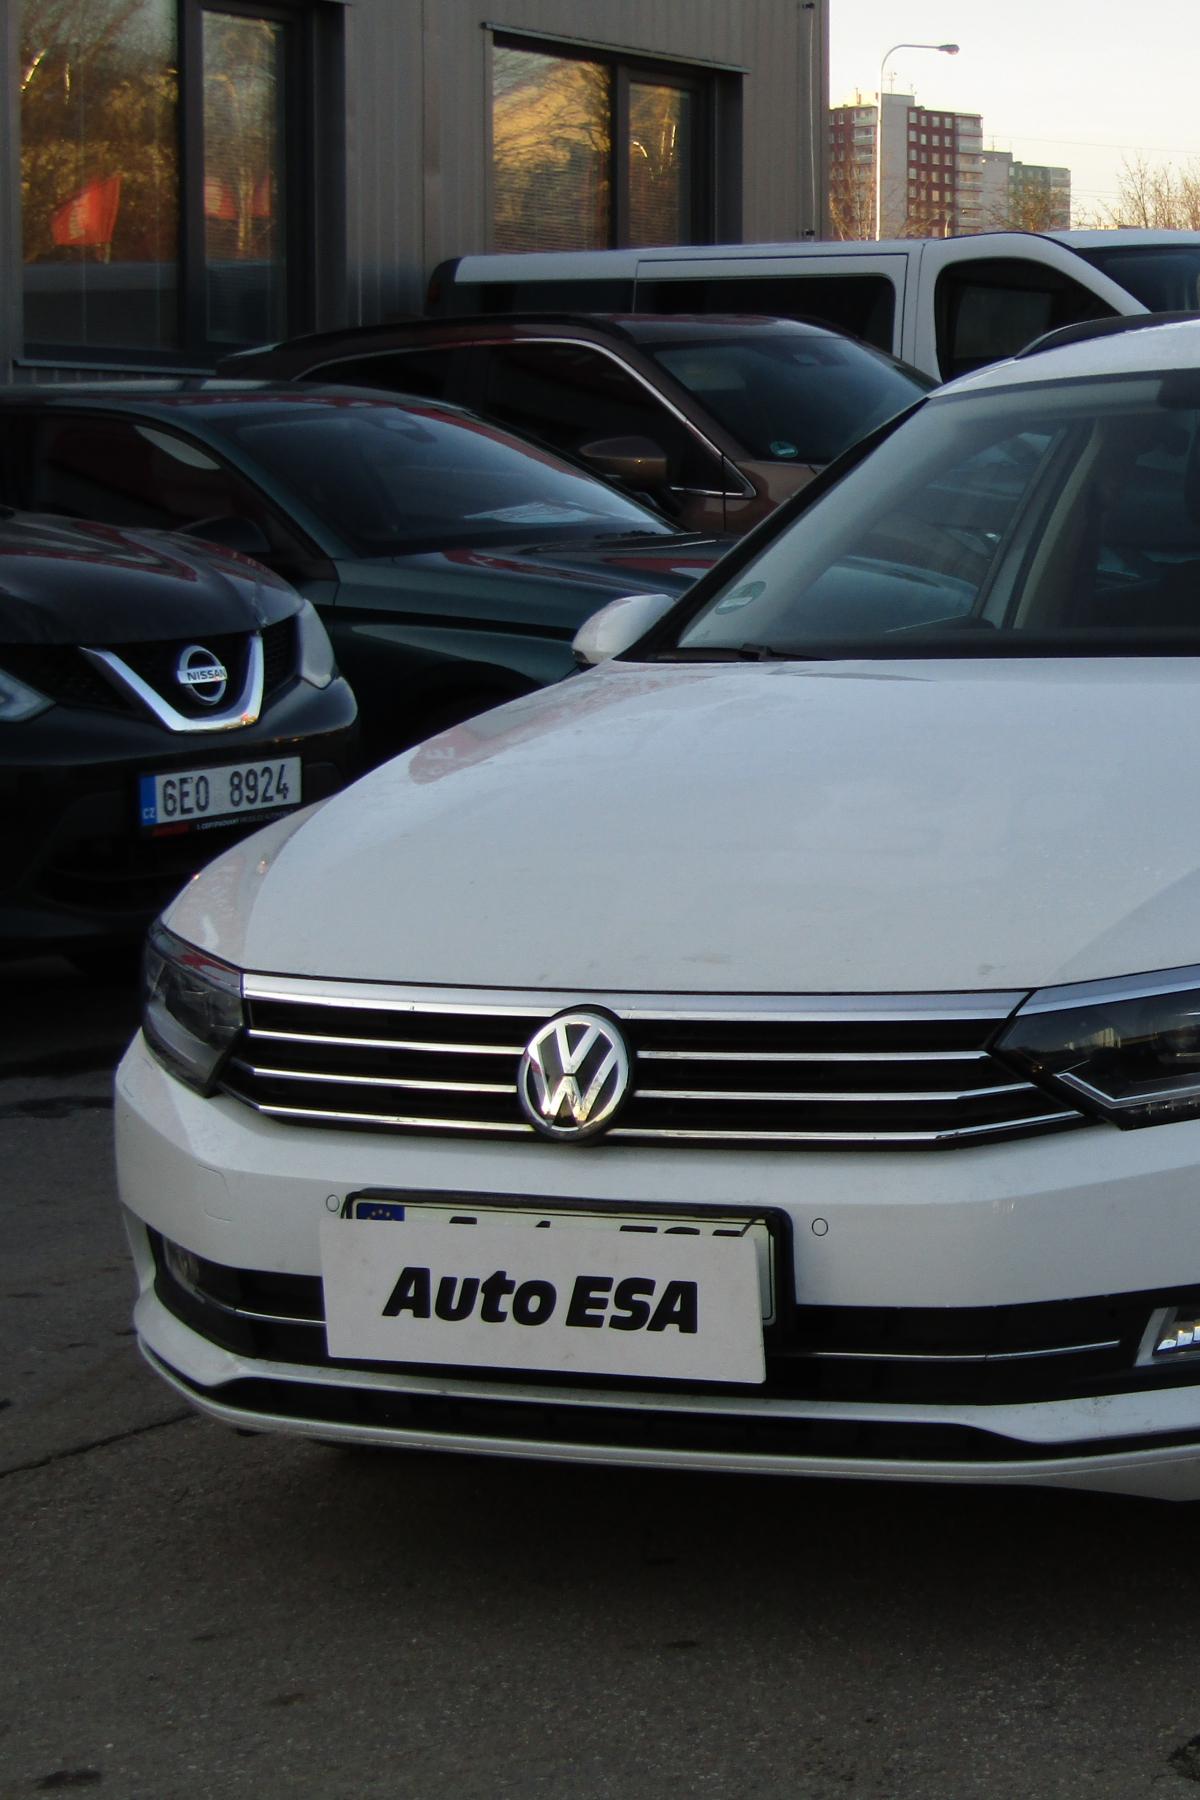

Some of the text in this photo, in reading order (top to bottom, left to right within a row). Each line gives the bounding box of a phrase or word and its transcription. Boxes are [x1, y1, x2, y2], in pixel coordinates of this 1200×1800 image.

[186, 669, 225, 681] NISSAN
[229, 764, 289, 808] 8924
[382, 1266, 698, 1334] Auto ESA
